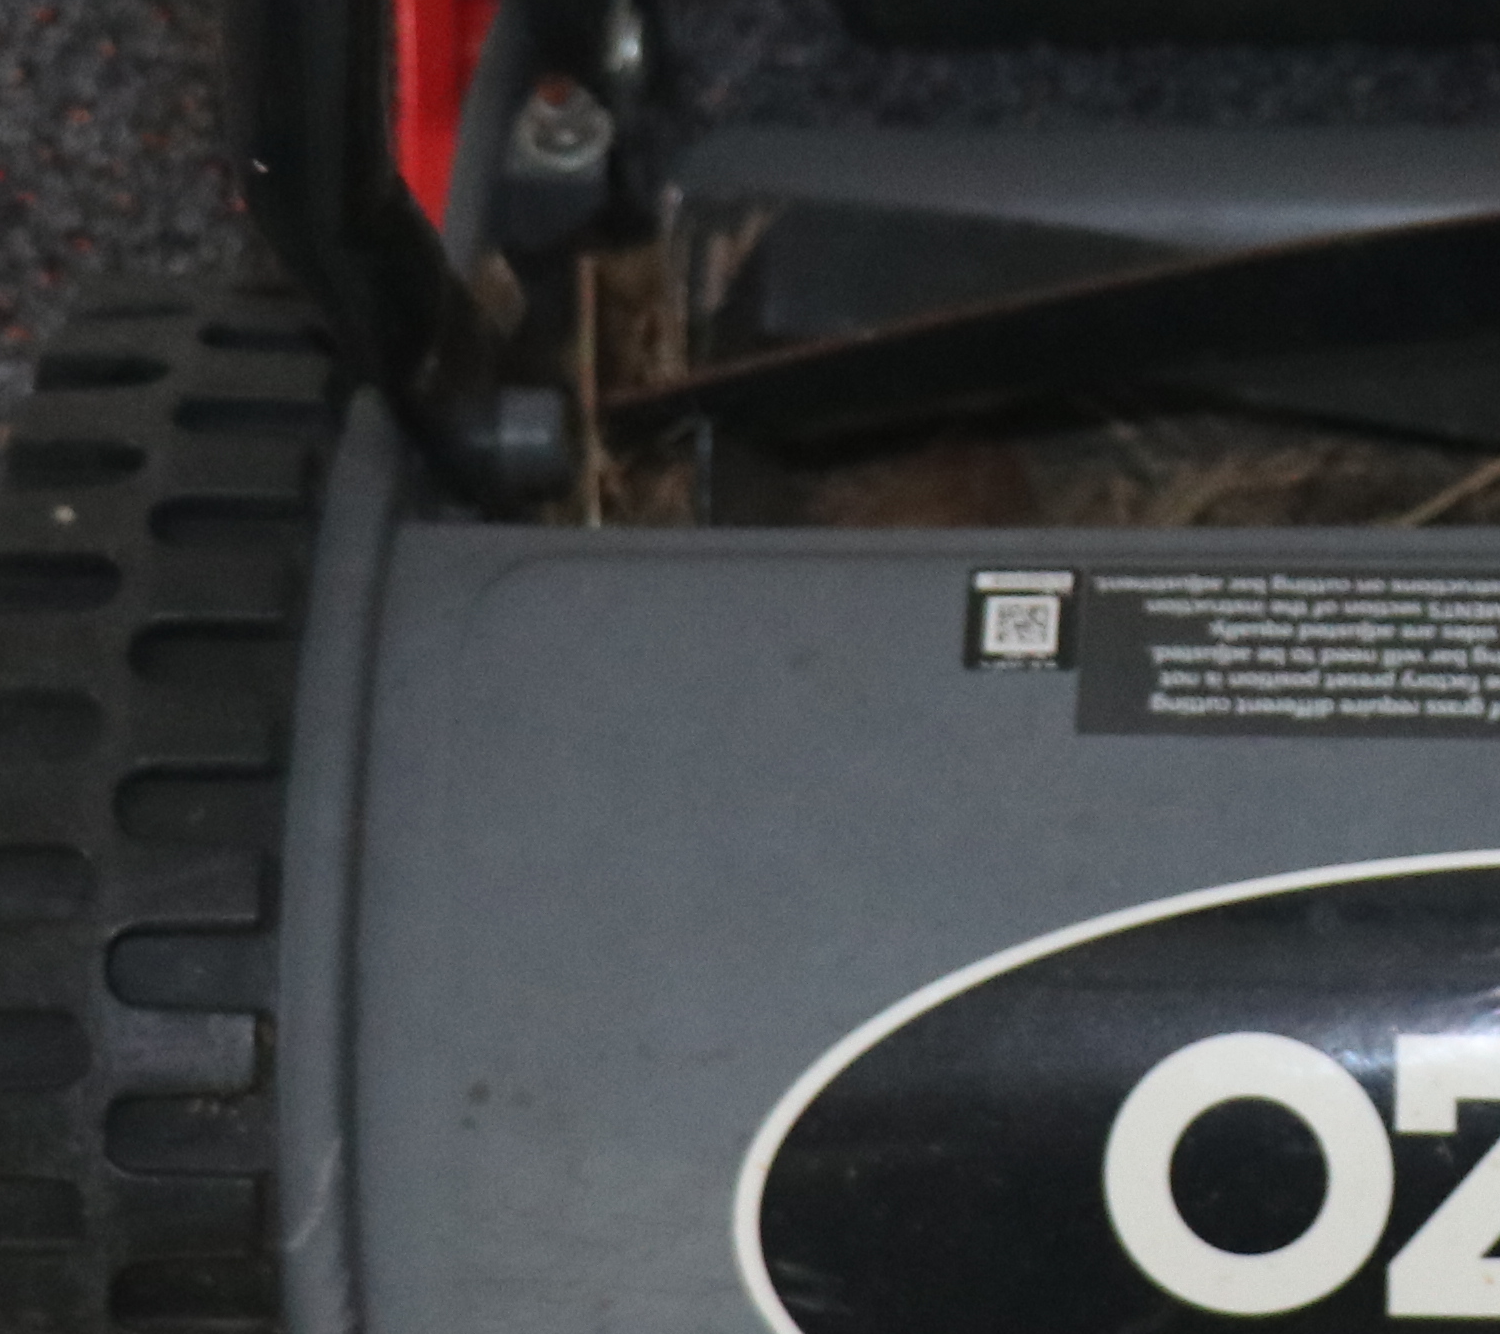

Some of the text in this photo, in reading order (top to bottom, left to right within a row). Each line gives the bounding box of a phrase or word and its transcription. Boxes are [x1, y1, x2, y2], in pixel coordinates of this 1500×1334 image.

[1144, 599, 1266, 615] instruction
[1270, 600, 1308, 617] the
[1311, 600, 1340, 617] of
[1344, 600, 1422, 617] section
[1299, 622, 1396, 641] adjusted
[1401, 624, 1438, 639] are
[1257, 647, 1286, 666] be
[1290, 647, 1316, 663] to
[1319, 647, 1378, 665] need
[1382, 648, 1425, 667] will
[1429, 648, 1468, 668] bar
[1158, 670, 1201, 686] not
[1204, 671, 1224, 688] is
[1228, 670, 1320, 688] position
[1401, 669, 1481, 693] factory
[1149, 692, 1231, 714] cutting
[1236, 697, 1335, 718] different
[1340, 696, 1421, 716] require
[1425, 697, 1485, 716] grass
